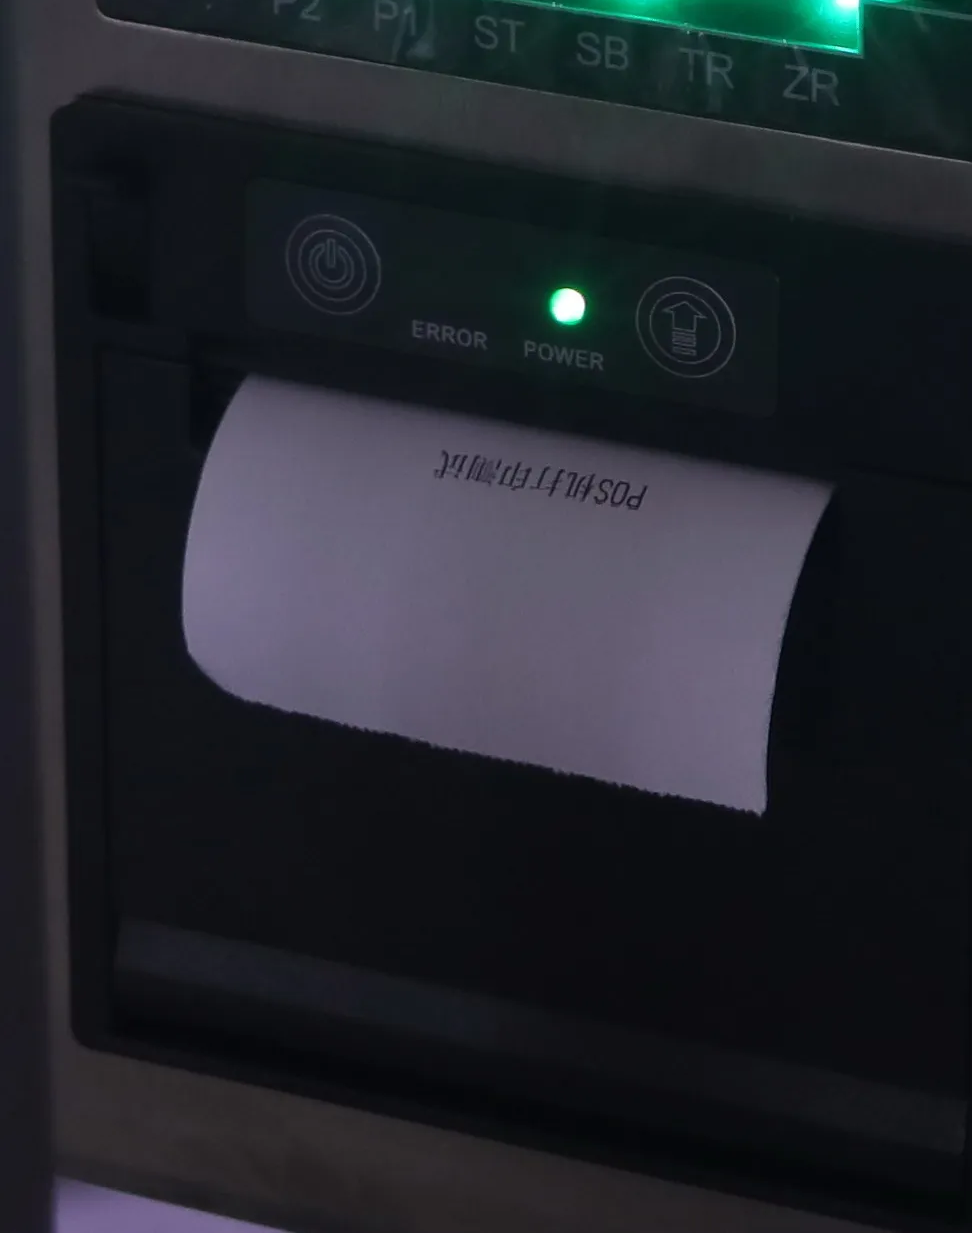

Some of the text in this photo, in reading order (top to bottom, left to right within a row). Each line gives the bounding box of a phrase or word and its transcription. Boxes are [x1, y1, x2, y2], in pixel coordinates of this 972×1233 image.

[473, 14, 525, 53] ST
[575, 31, 630, 71] SB
[678, 46, 735, 90] TR
[782, 63, 840, 107] ZR
[411, 318, 489, 351] ERROR
[523, 339, 605, 371] POWER
[434, 449, 648, 511] POS机打印测试
